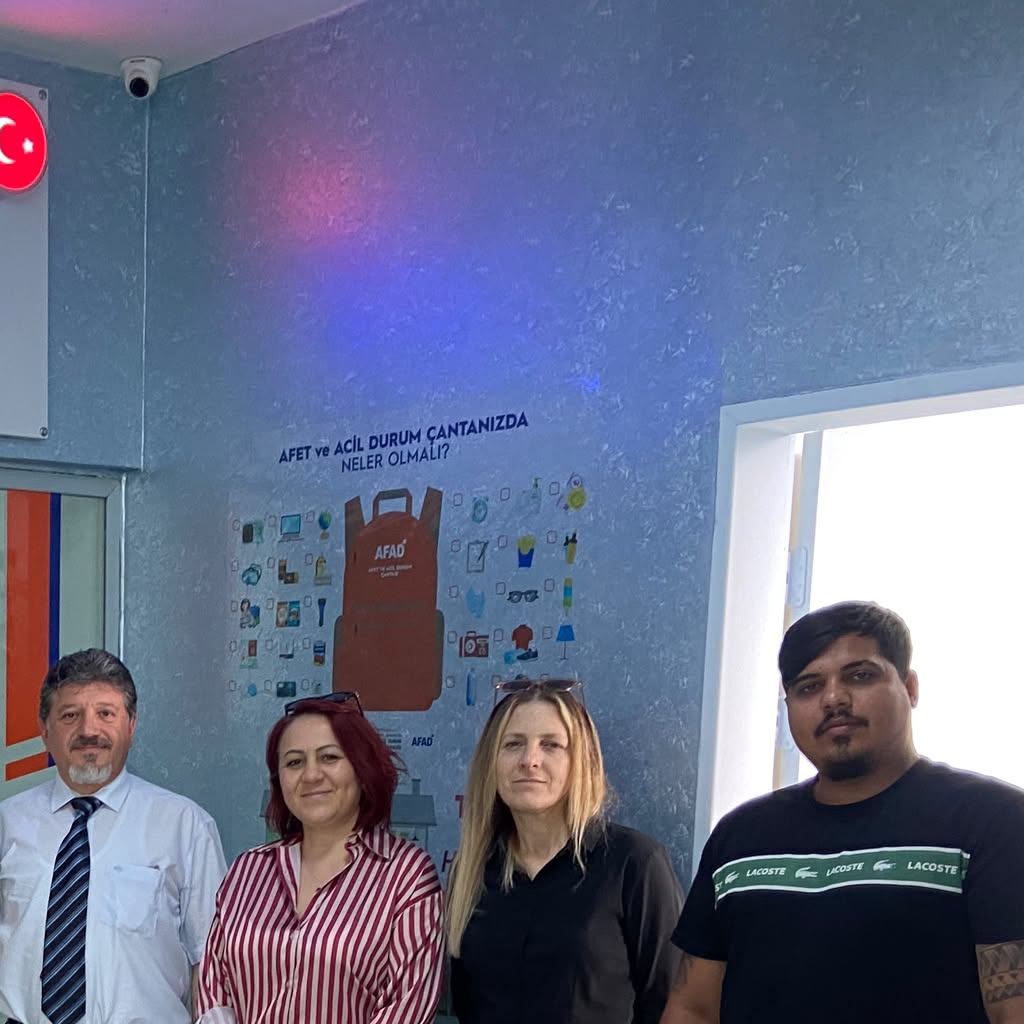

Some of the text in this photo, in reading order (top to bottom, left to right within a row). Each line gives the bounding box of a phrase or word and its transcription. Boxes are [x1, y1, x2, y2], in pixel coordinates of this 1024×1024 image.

[279, 411, 529, 464] AFET ve ACİL DURUM ÇANTANIZDA
[341, 442, 450, 473] NELER OLMALI?
[374, 543, 405, 560] AFAD
[411, 736, 433, 747] AFAD
[746, 867, 787, 877] LACOSTE
[826, 861, 865, 877] LACOSTE
[907, 861, 959, 875] LACOSTE
